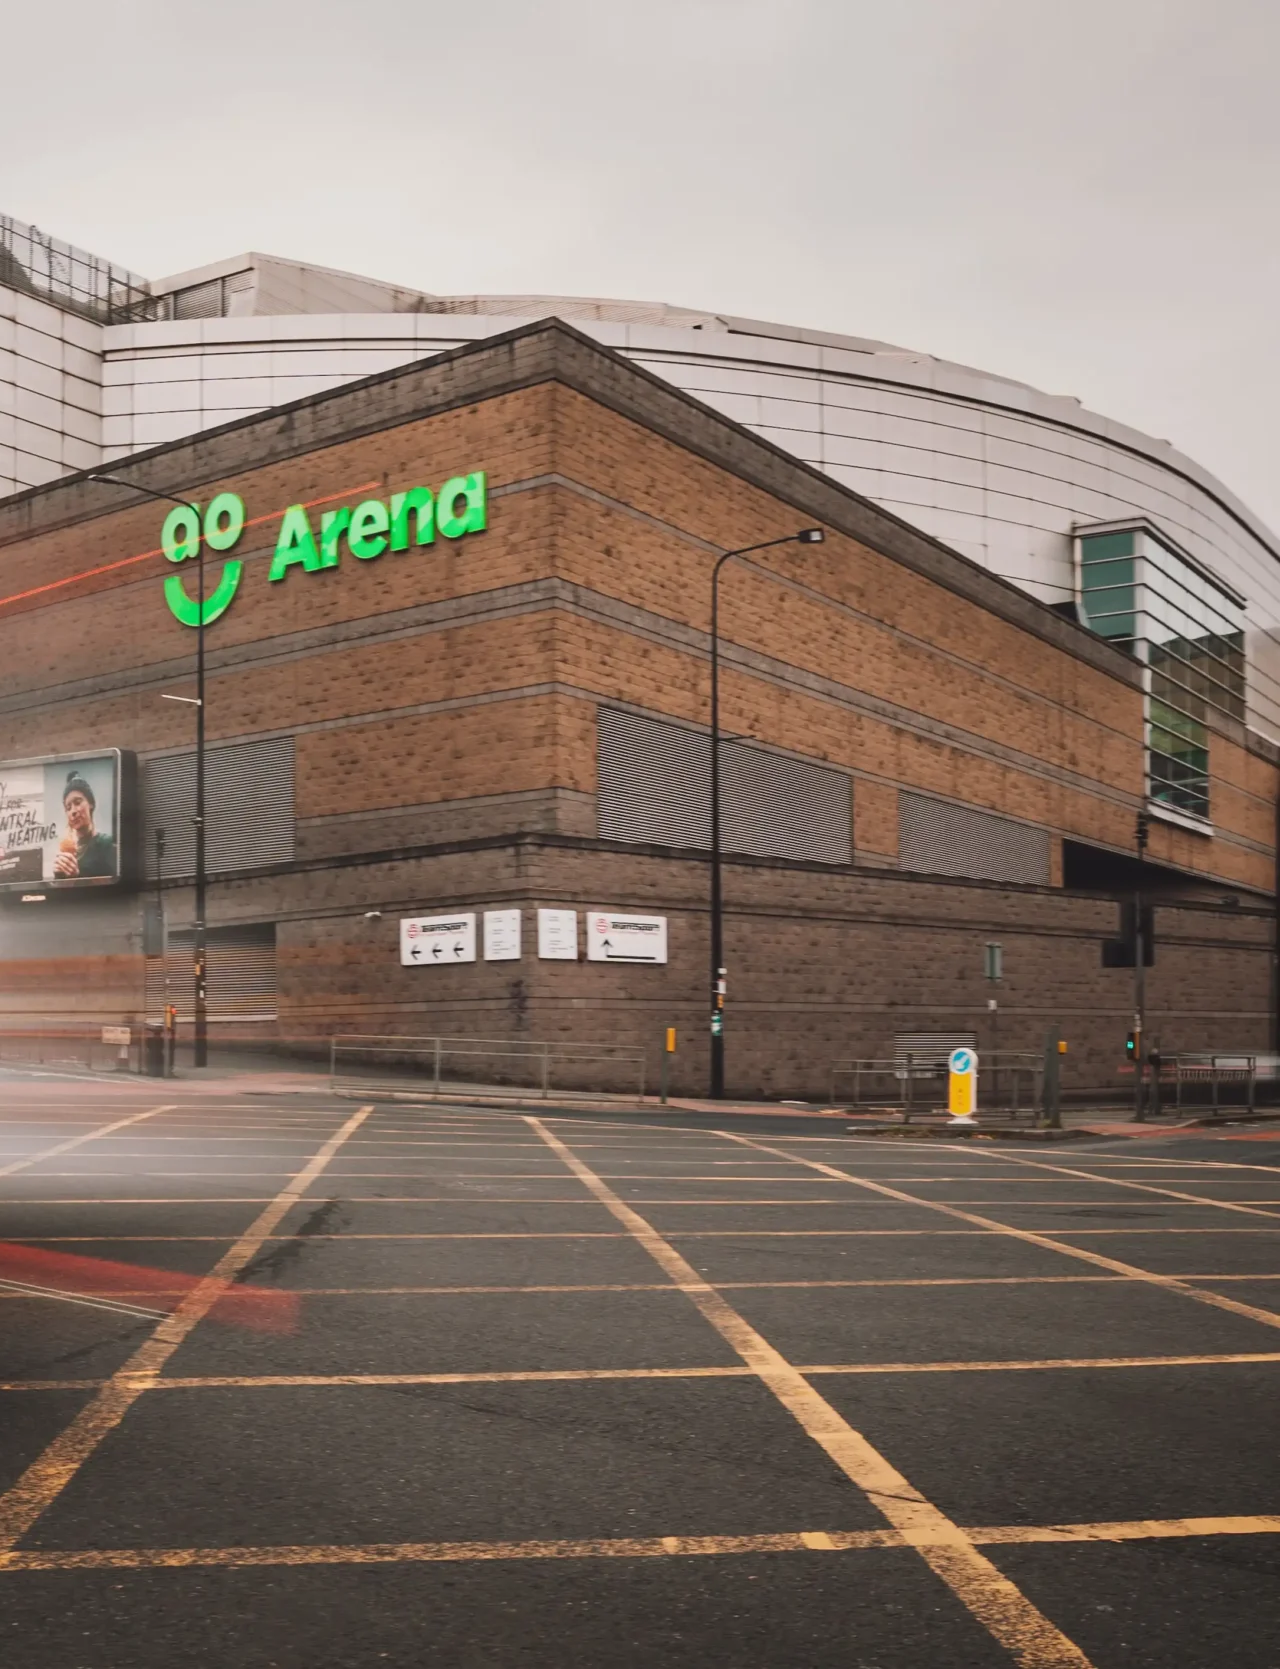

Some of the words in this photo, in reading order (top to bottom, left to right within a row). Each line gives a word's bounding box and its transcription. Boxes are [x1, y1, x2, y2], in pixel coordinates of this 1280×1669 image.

[162, 493, 245, 562] ao
[268, 471, 486, 580] Arena
[7, 822, 59, 849] HEATING.
